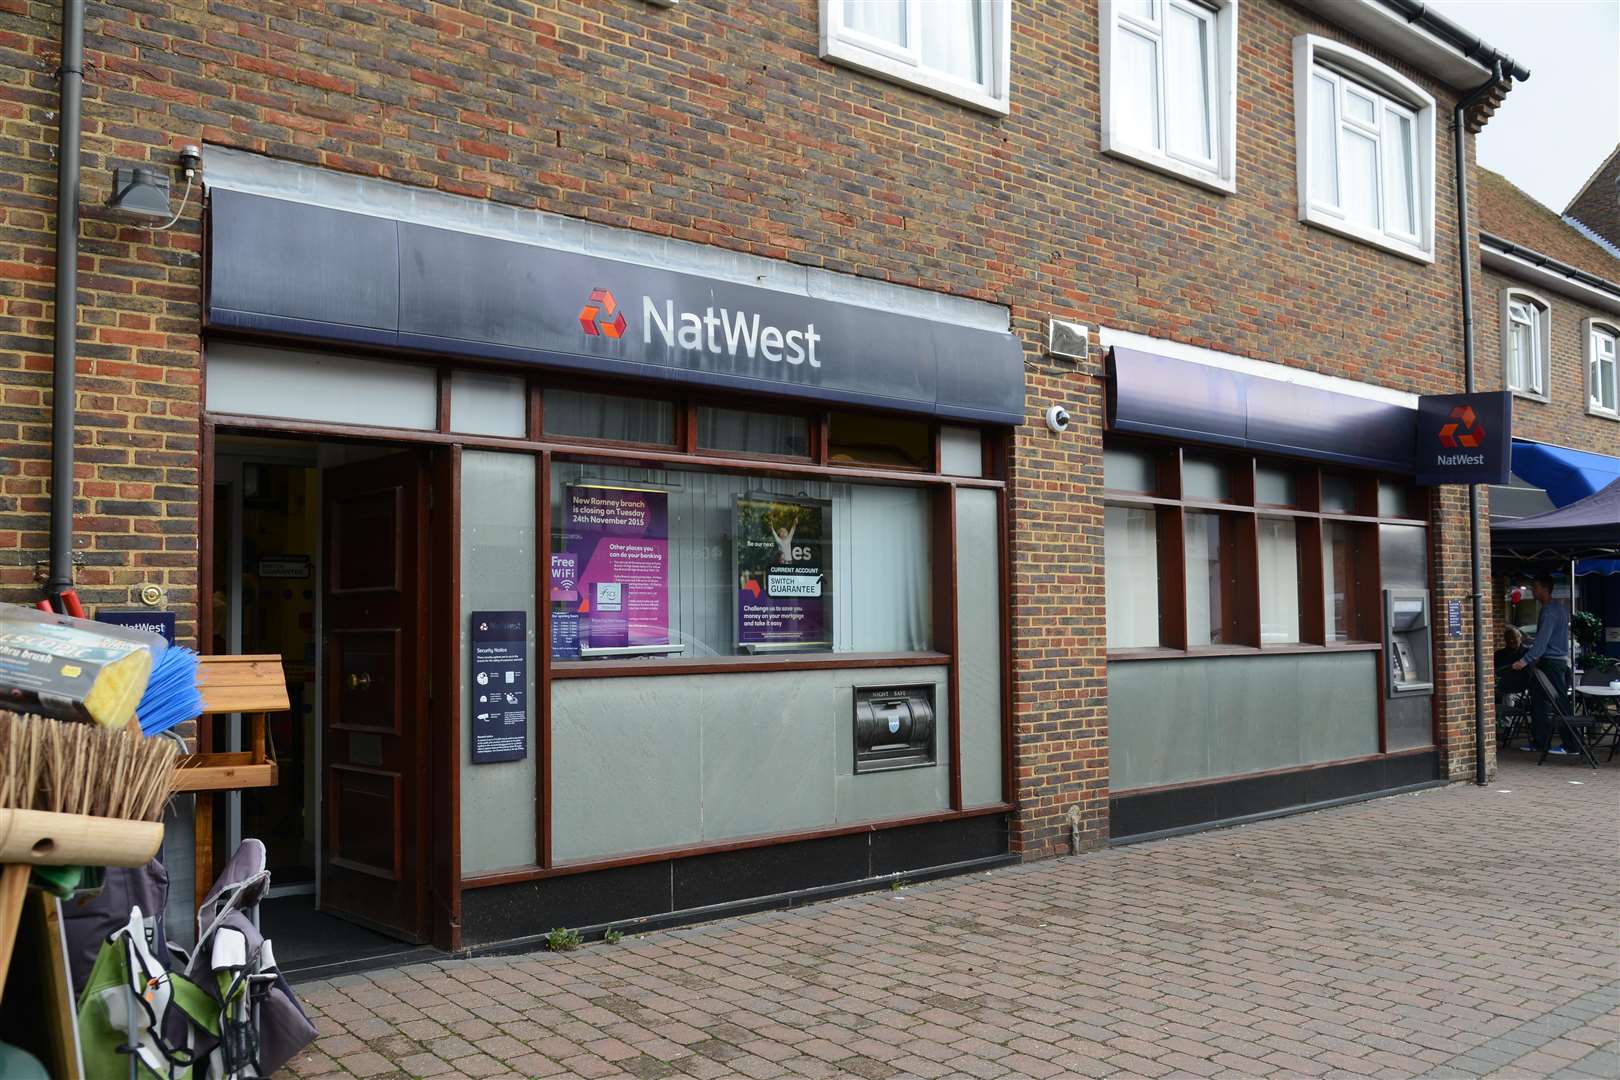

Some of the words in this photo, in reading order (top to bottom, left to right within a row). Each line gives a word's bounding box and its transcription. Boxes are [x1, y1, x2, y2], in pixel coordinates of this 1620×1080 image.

[642, 295, 821, 368] NatWest
[1437, 454, 1484, 466] NatWest
[573, 496, 590, 504] New
[591, 497, 619, 507] Romney
[620, 499, 645, 508] branch
[573, 505, 578, 513] is
[580, 506, 604, 516] closing
[616, 508, 645, 518] Tuesday
[573, 515, 589, 523] 24th
[590, 516, 627, 525] November
[628, 518, 644, 526] 2015
[551, 556, 575, 567] Free
[640, 552, 662, 560] banking
[551, 568, 575, 578] WiFi
[770, 577, 795, 585] SWITCH
[770, 585, 815, 593] GUARANTEE
[743, 605, 769, 613] Challenge
[21, 648, 53, 663] brush
